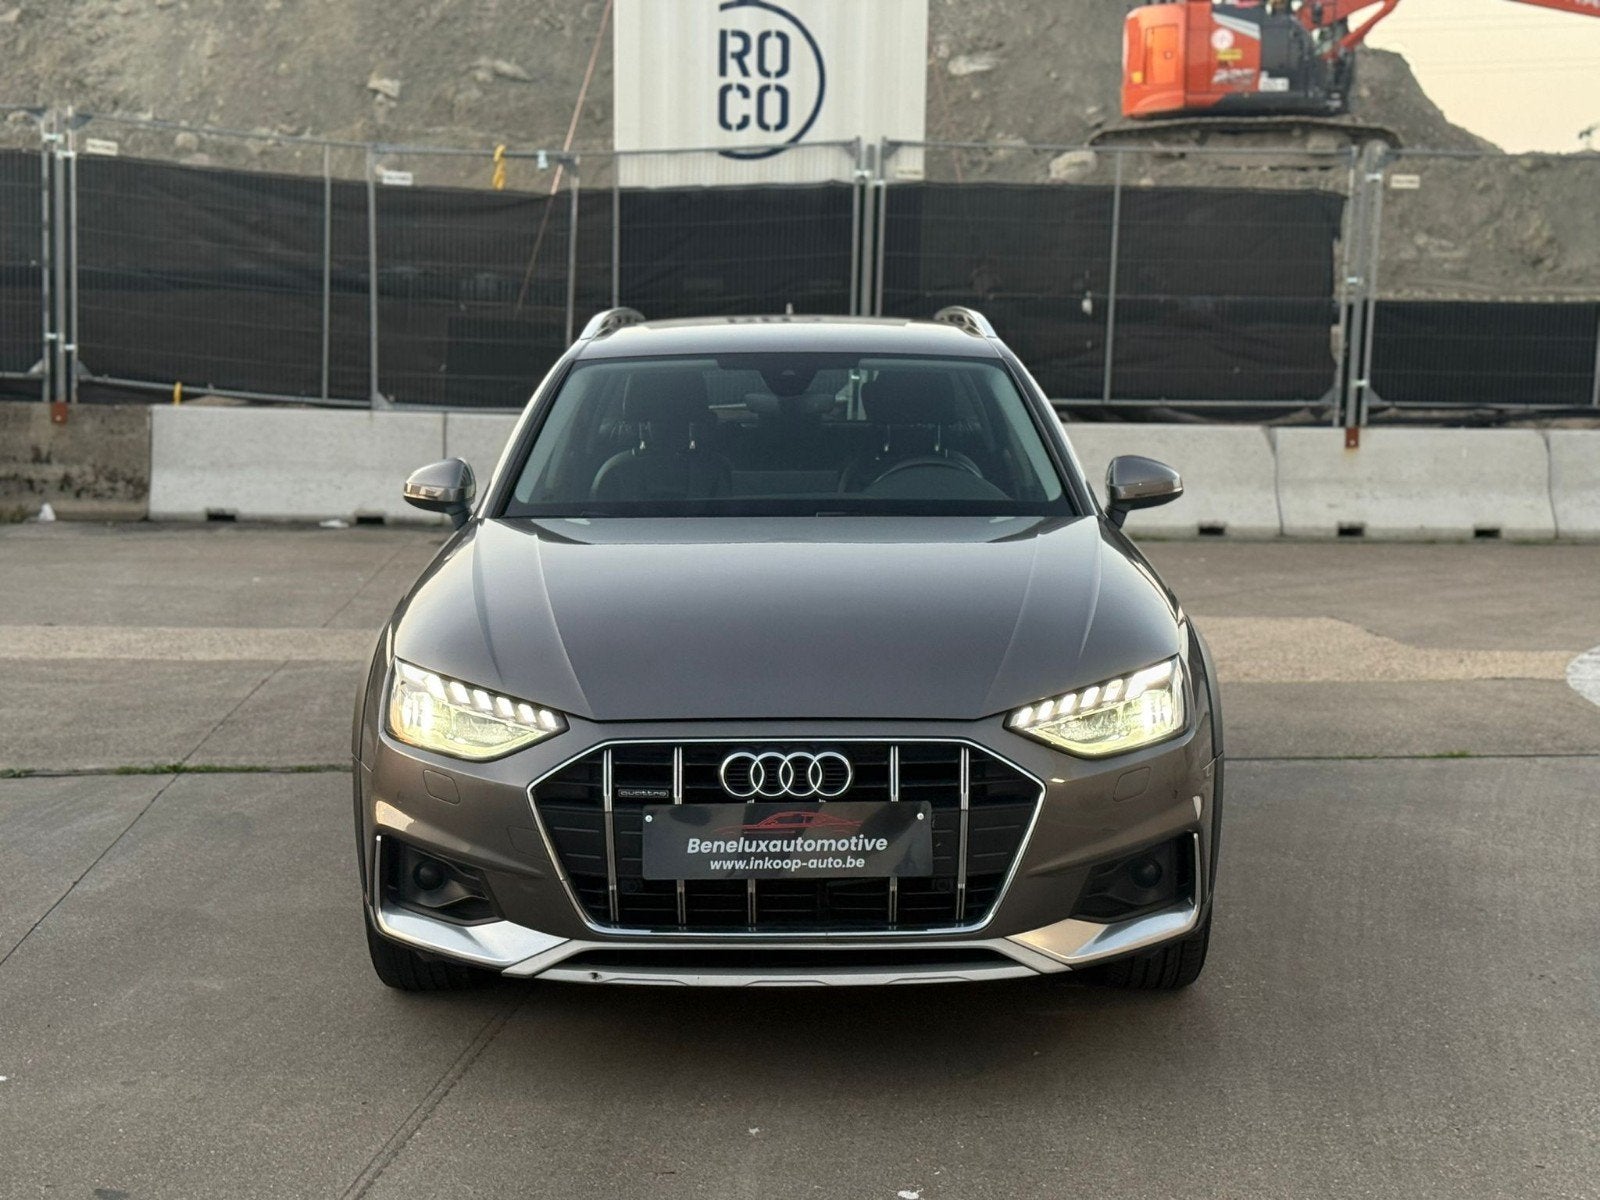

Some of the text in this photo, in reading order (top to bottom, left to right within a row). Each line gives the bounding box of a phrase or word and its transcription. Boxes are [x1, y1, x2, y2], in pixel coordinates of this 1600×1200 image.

[719, 29, 790, 78] RO
[719, 83, 789, 132] CO
[687, 834, 888, 854] Beneluxautomotive
[710, 856, 865, 872] www.inkoop-auto.be
